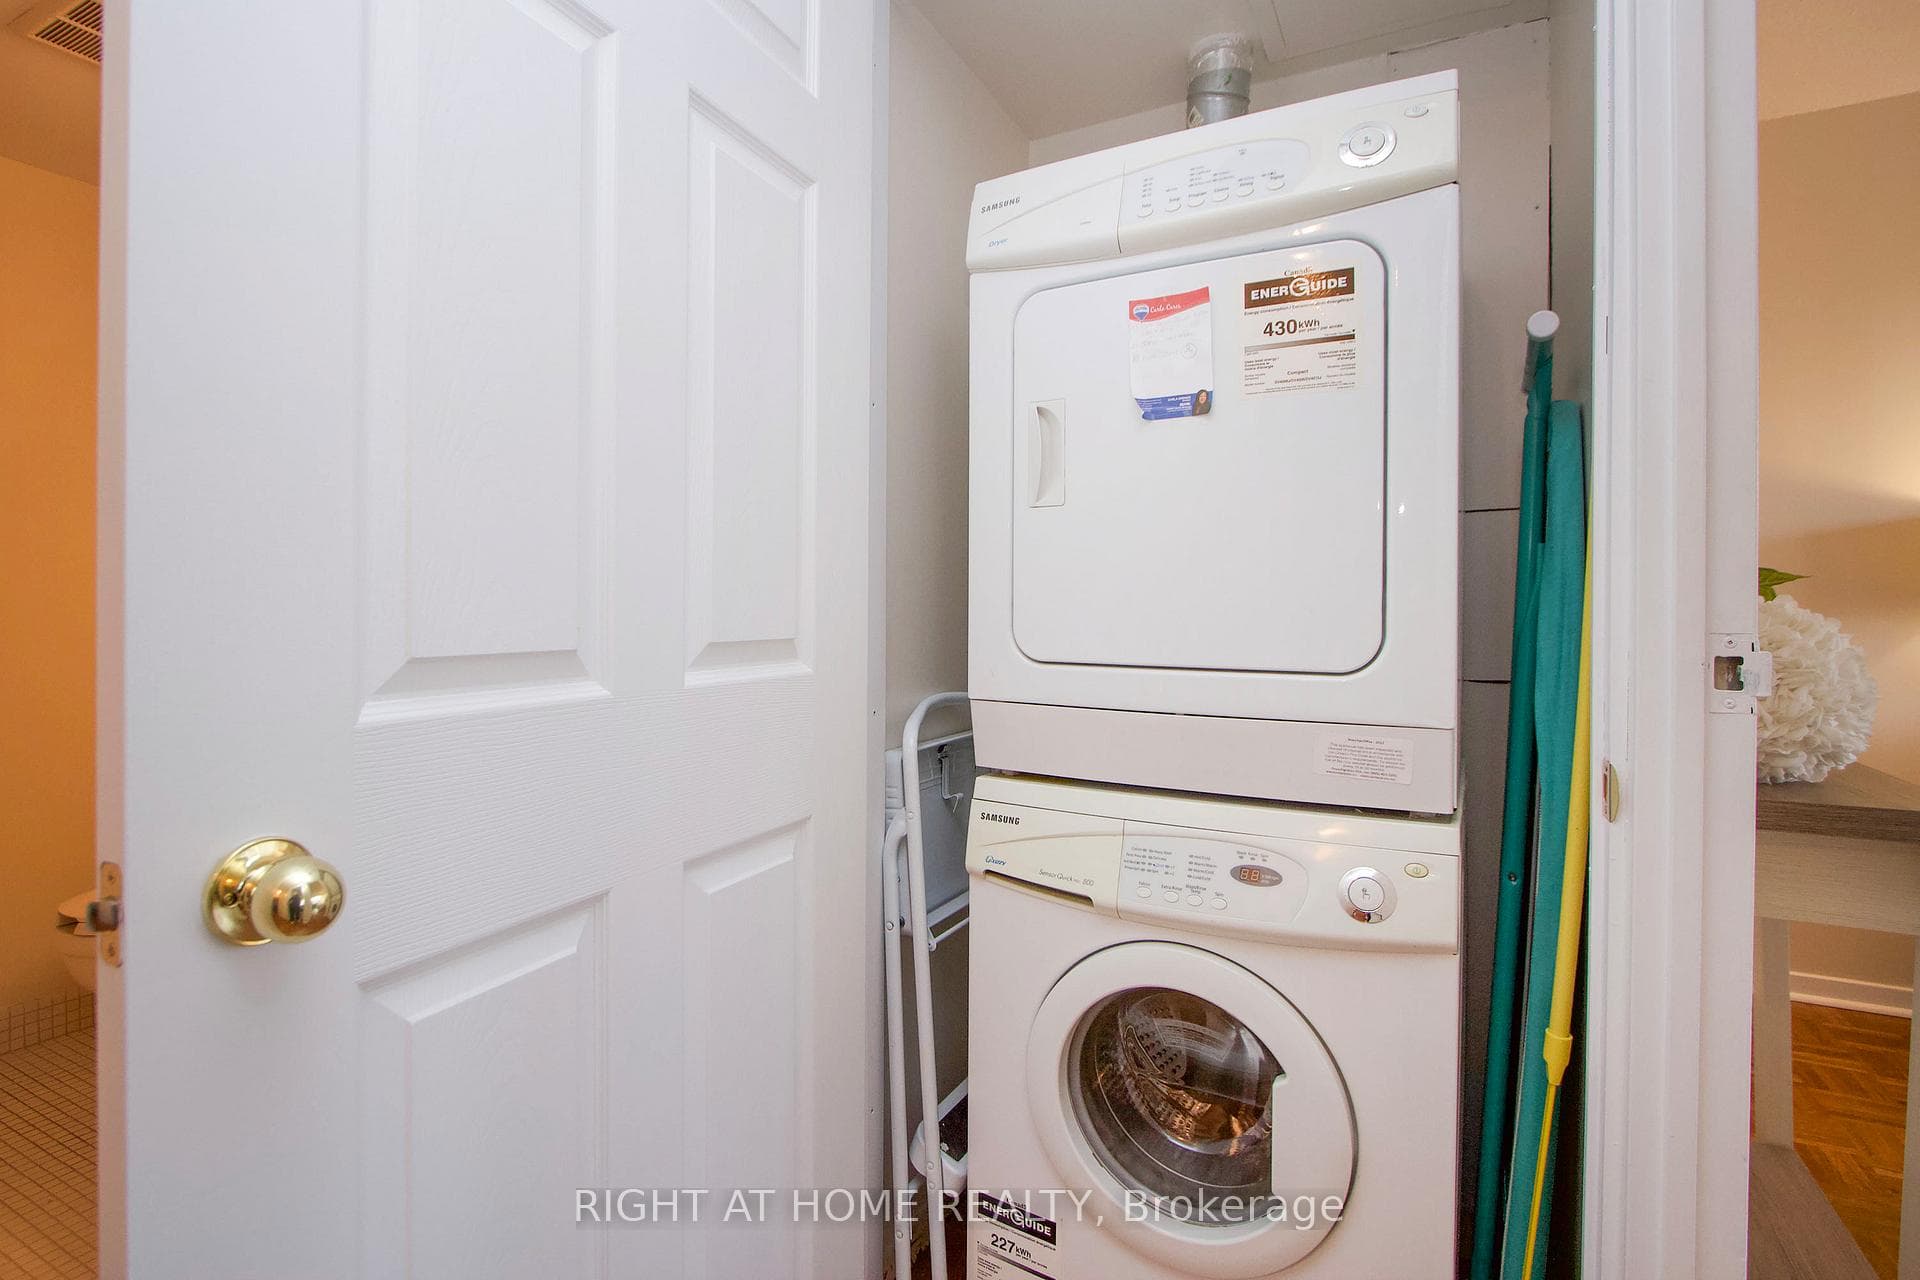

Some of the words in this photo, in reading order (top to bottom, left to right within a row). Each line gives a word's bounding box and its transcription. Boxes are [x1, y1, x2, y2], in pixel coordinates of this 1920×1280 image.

[981, 196, 1021, 214] SAMSUNG
[1263, 319, 1297, 337] 430
[1298, 319, 1320, 329] kWh
[980, 812, 1020, 825] SAMSUNG
[990, 1233, 1015, 1253] 227
[1015, 1245, 1032, 1259] kWh
